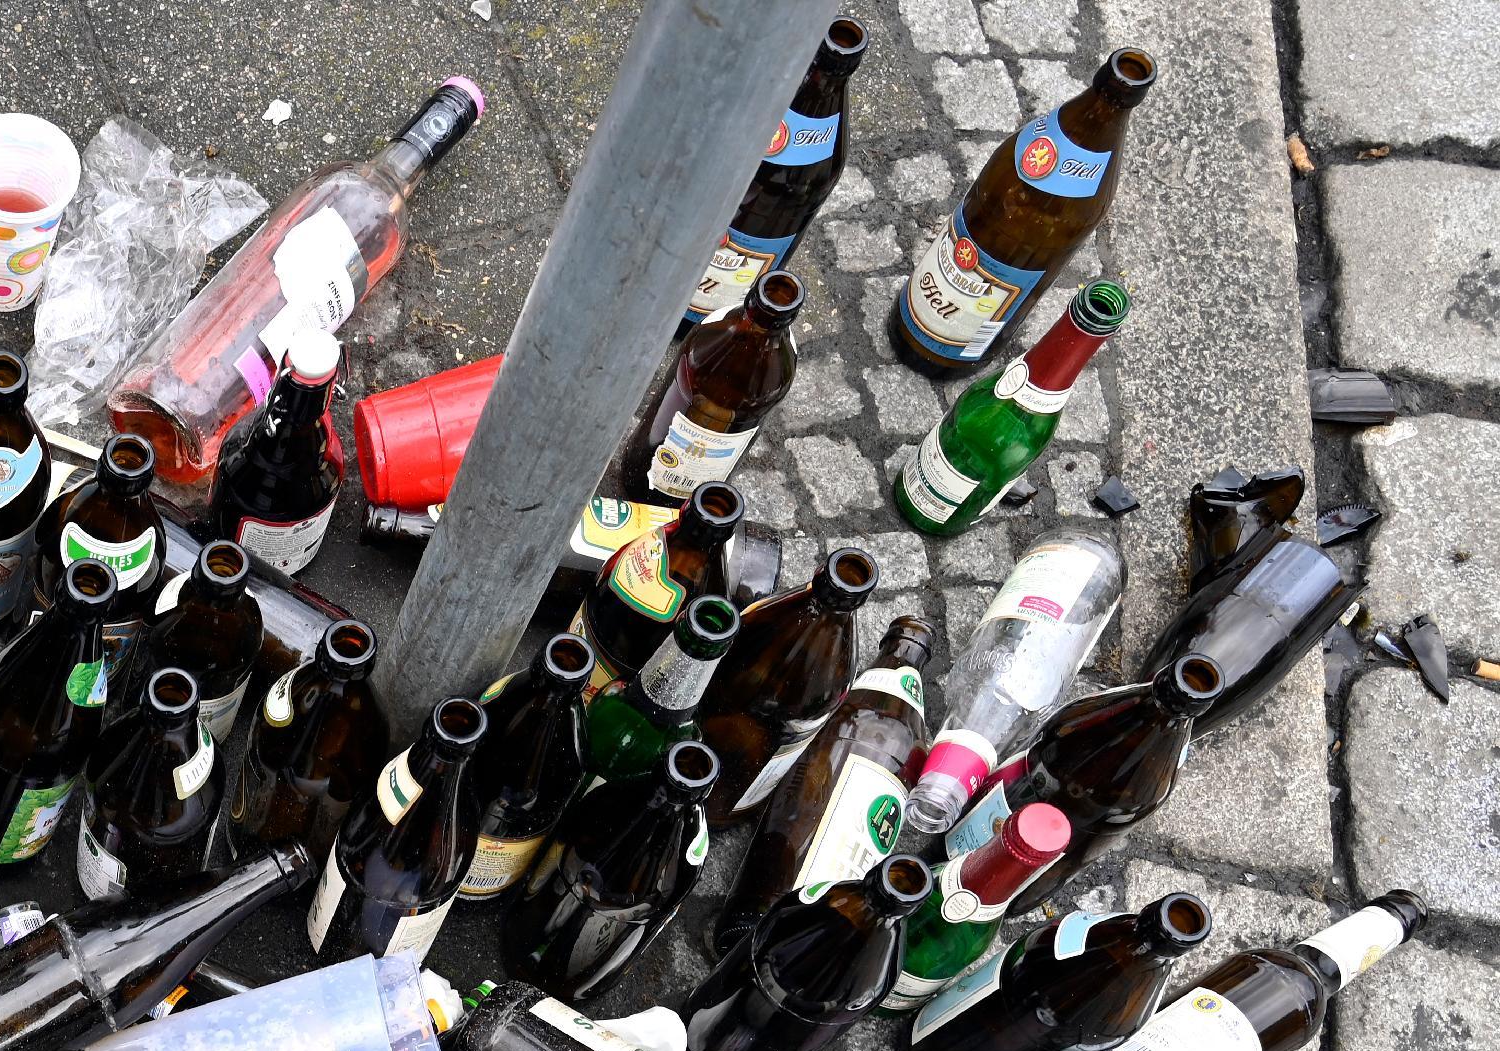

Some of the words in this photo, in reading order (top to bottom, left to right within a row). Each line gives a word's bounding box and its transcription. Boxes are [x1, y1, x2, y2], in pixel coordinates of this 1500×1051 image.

[794, 125, 835, 147] Hell
[1033, 114, 1050, 136] ell
[1059, 159, 1103, 180] Hell
[919, 271, 960, 321] Hell
